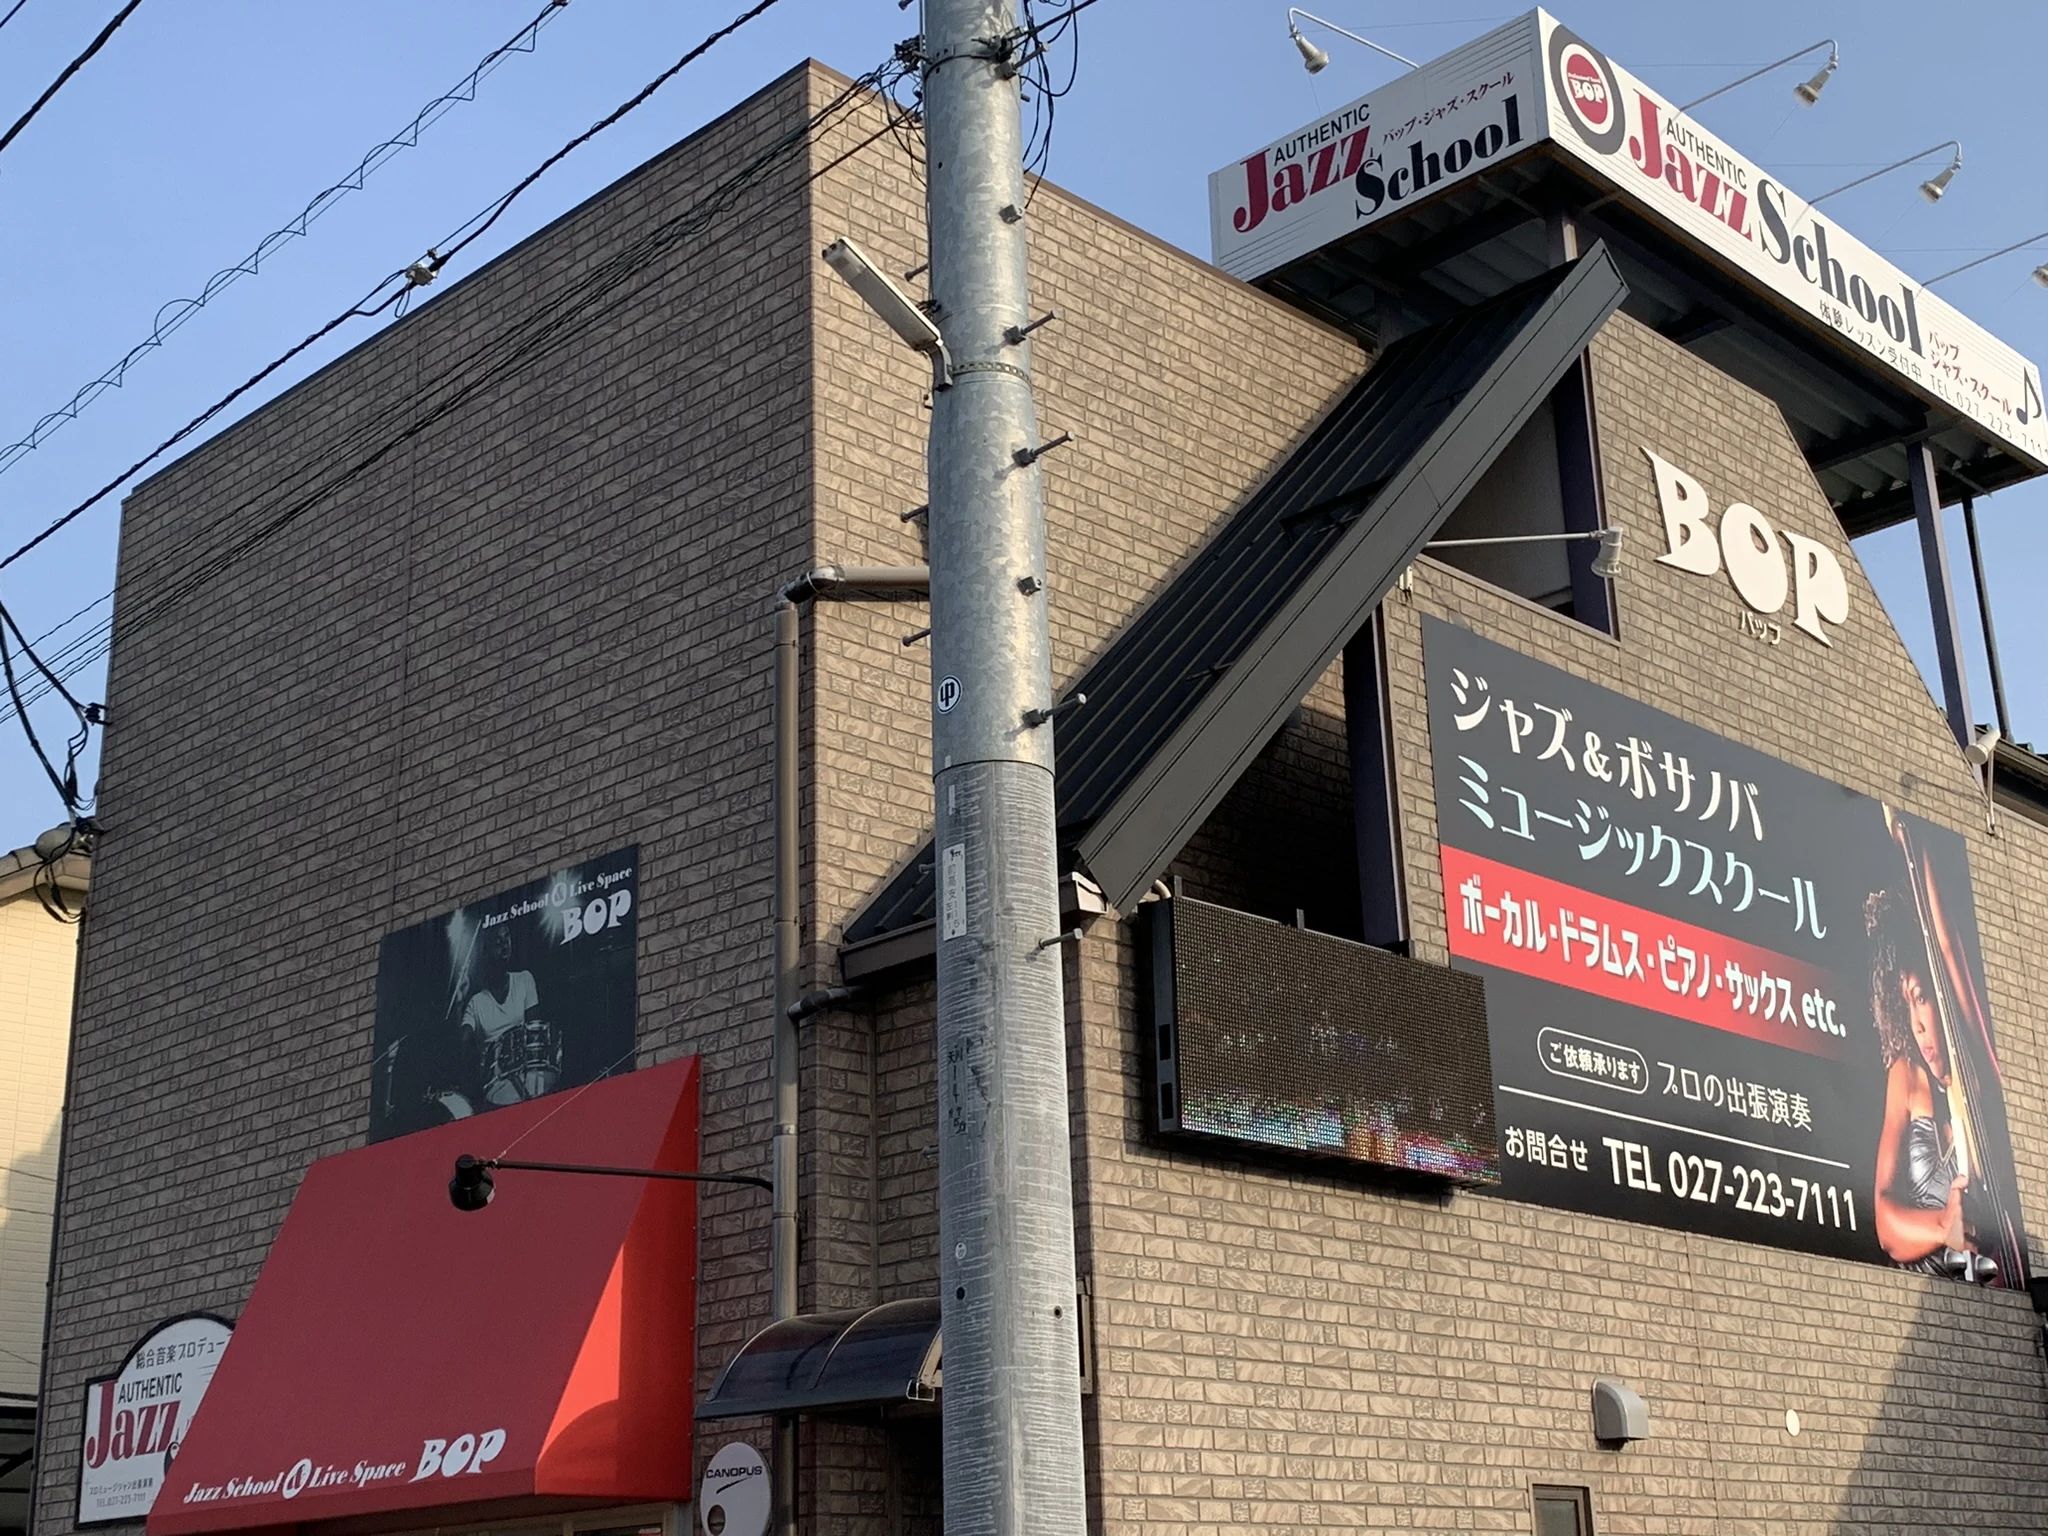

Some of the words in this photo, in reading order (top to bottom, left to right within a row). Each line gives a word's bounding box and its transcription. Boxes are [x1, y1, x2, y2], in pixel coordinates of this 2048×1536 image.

[1382, 71, 1515, 145] バップ・ジャズ・スクール
[1569, 79, 1604, 103] BOP
[1233, 125, 1371, 233] Jazz
[1355, 94, 1523, 220] School
[1273, 103, 1370, 167] AUTHENTIC
[1666, 117, 1747, 190] AUTHENTIC
[1629, 89, 1752, 241] Jazz
[1757, 179, 1926, 359] School
[1929, 331, 1959, 361] バップ
[1931, 350, 2012, 416] ジャズ・スクール
[1639, 445, 1849, 648] BOP
[1739, 610, 1781, 645] バップ
[1450, 668, 1763, 841] ジャズ&ボサノバ
[1458, 755, 1827, 939] ミュージックスクール
[481, 911, 509, 929] Jazz
[509, 892, 549, 921] School
[569, 881, 596, 898] Live
[596, 866, 633, 890] Space
[560, 888, 633, 946] BOP
[1802, 987, 1847, 1038] etc.
[1549, 1041, 1641, 1085] ご依頼承ります
[1656, 1061, 1812, 1132] プロの出張演奏
[1505, 1126, 1589, 1172] お問合せ
[1602, 1137, 1661, 1193] TEL
[1668, 1150, 1858, 1232] 027-223-7111
[135, 1332, 232, 1371] 総合音楽プロデュー
[118, 1372, 182, 1404] AUTHENTIC
[86, 1379, 182, 1469] Jazz
[407, 1428, 507, 1483] BOP
[183, 1482, 222, 1504] Jazz
[221, 1471, 284, 1500] School
[307, 1464, 349, 1489] Live
[349, 1459, 407, 1489] Space
[706, 1465, 763, 1479] CANOPUS
